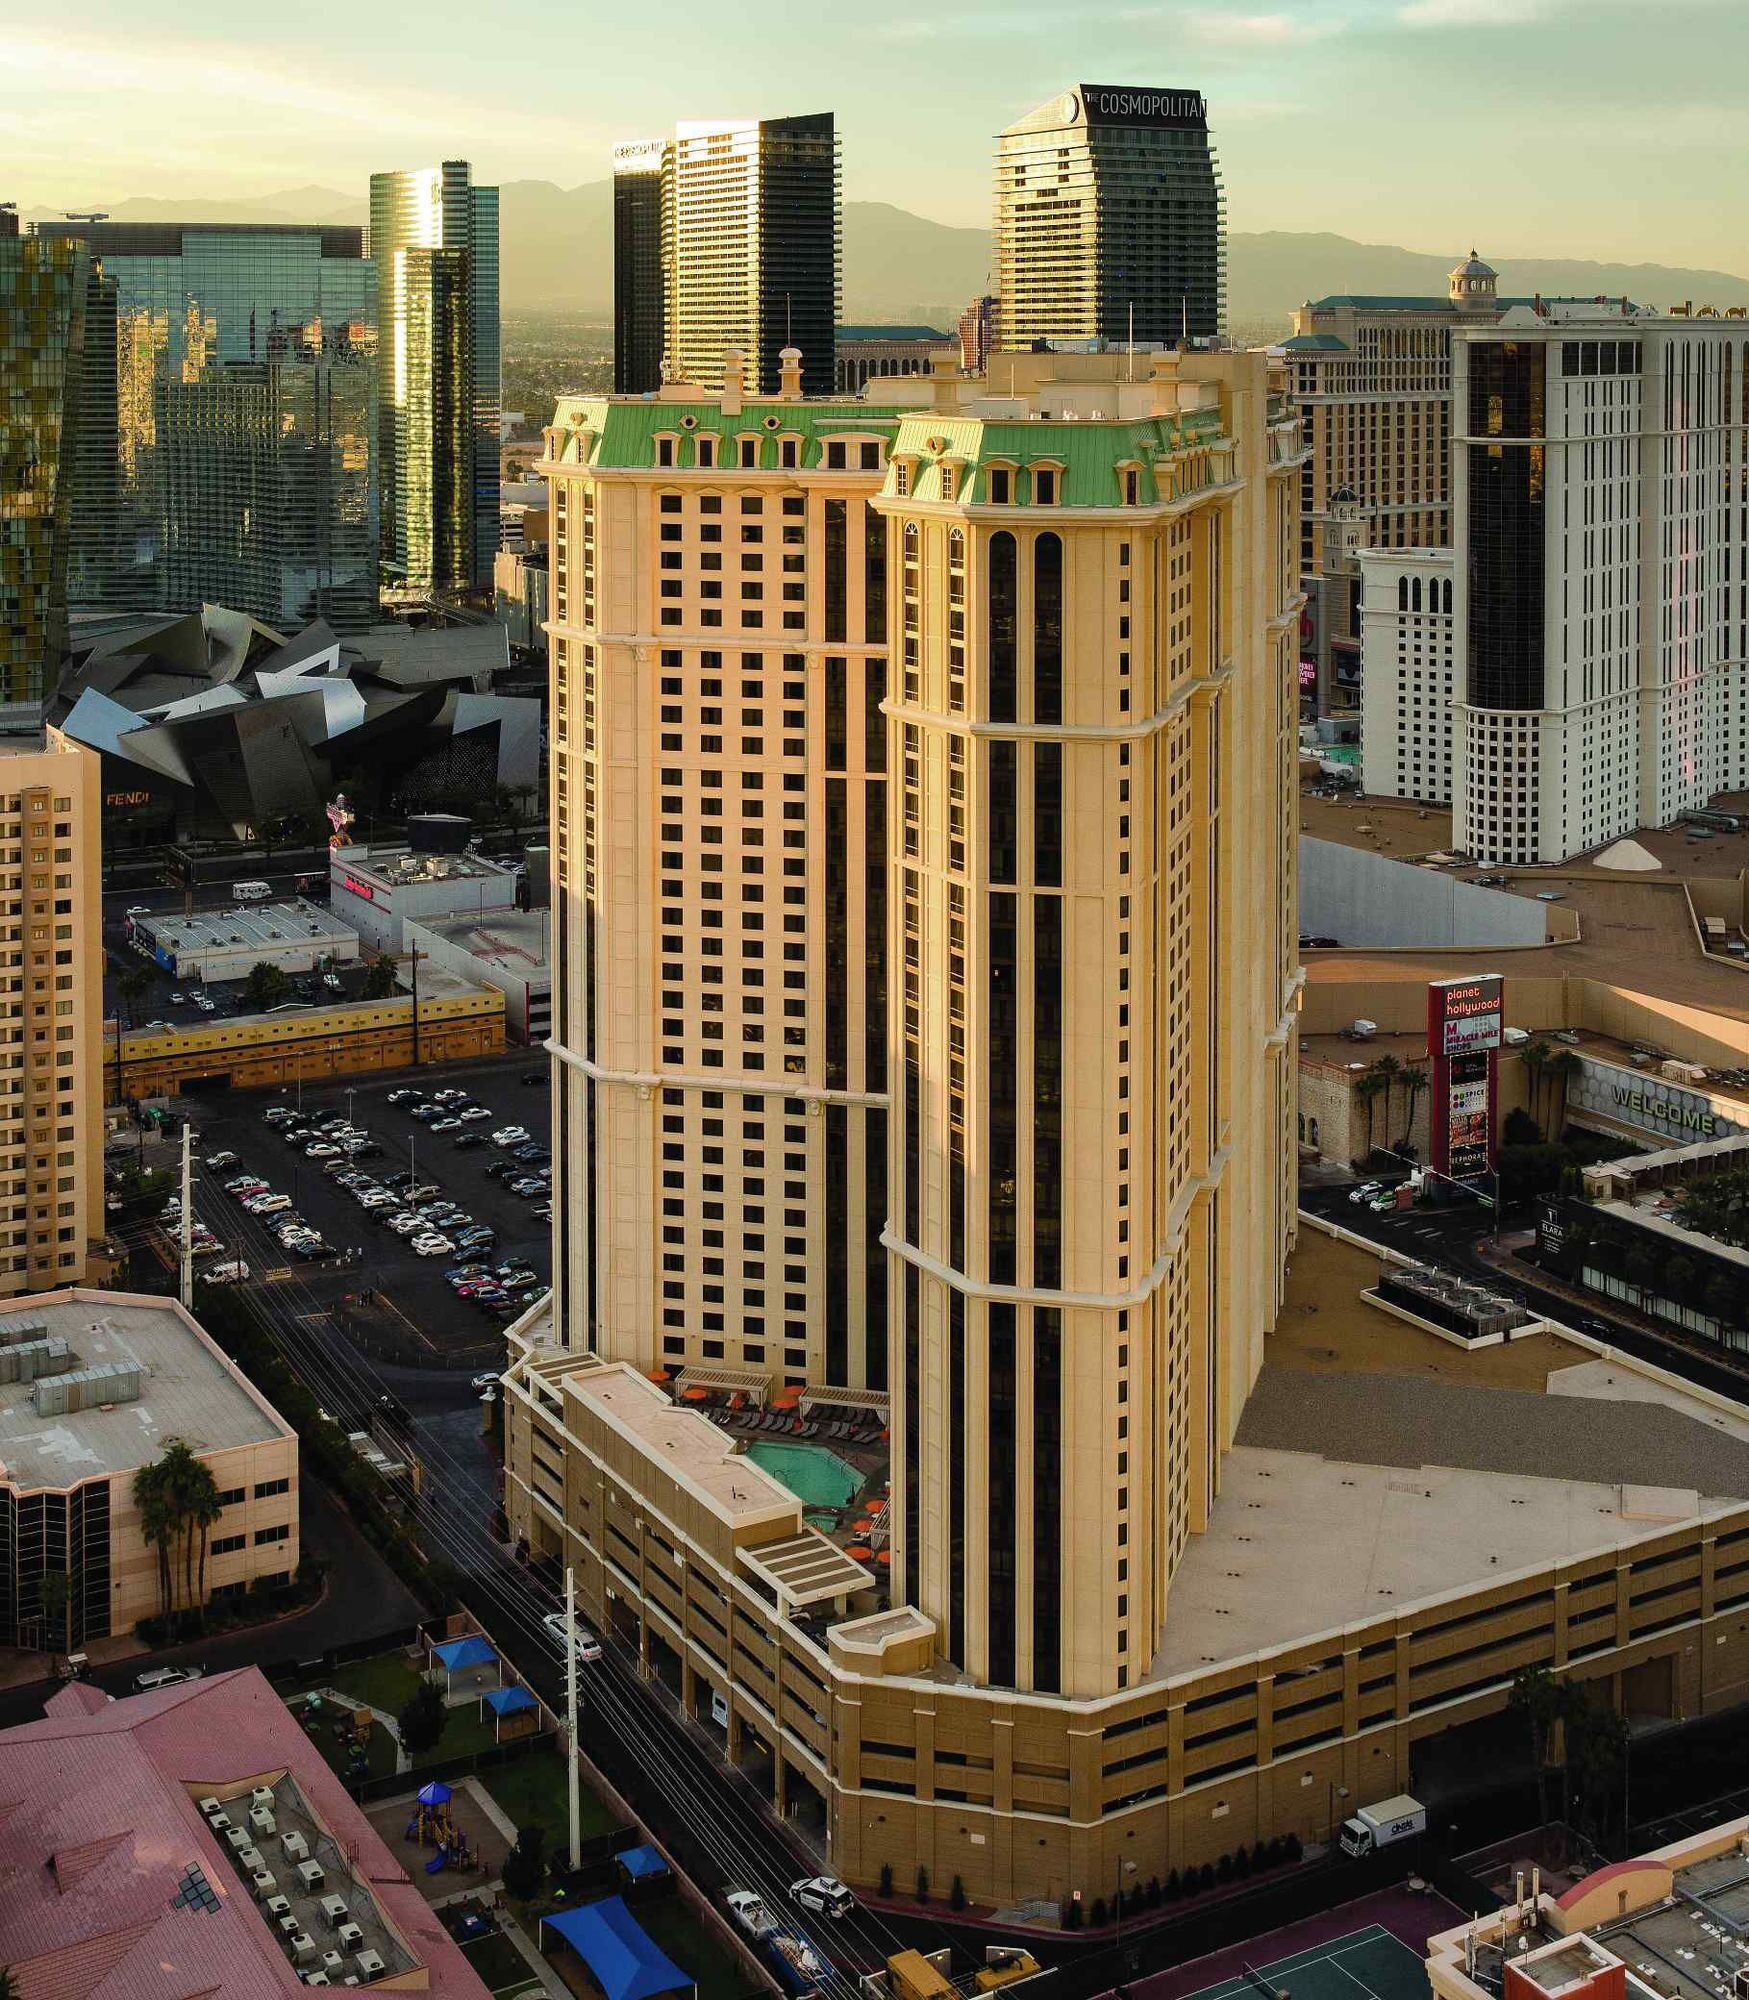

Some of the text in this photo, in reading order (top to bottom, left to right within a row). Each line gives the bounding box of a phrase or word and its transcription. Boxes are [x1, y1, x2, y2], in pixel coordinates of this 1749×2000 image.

[1100, 93, 1207, 118] COSMOPOLITAN
[107, 791, 150, 806] FENDI
[1447, 987, 1480, 1003] planet
[1447, 997, 1500, 1015] hollywood
[1612, 1085, 1713, 1134] WELCOME
[1542, 1223, 1563, 1236] ELARA
